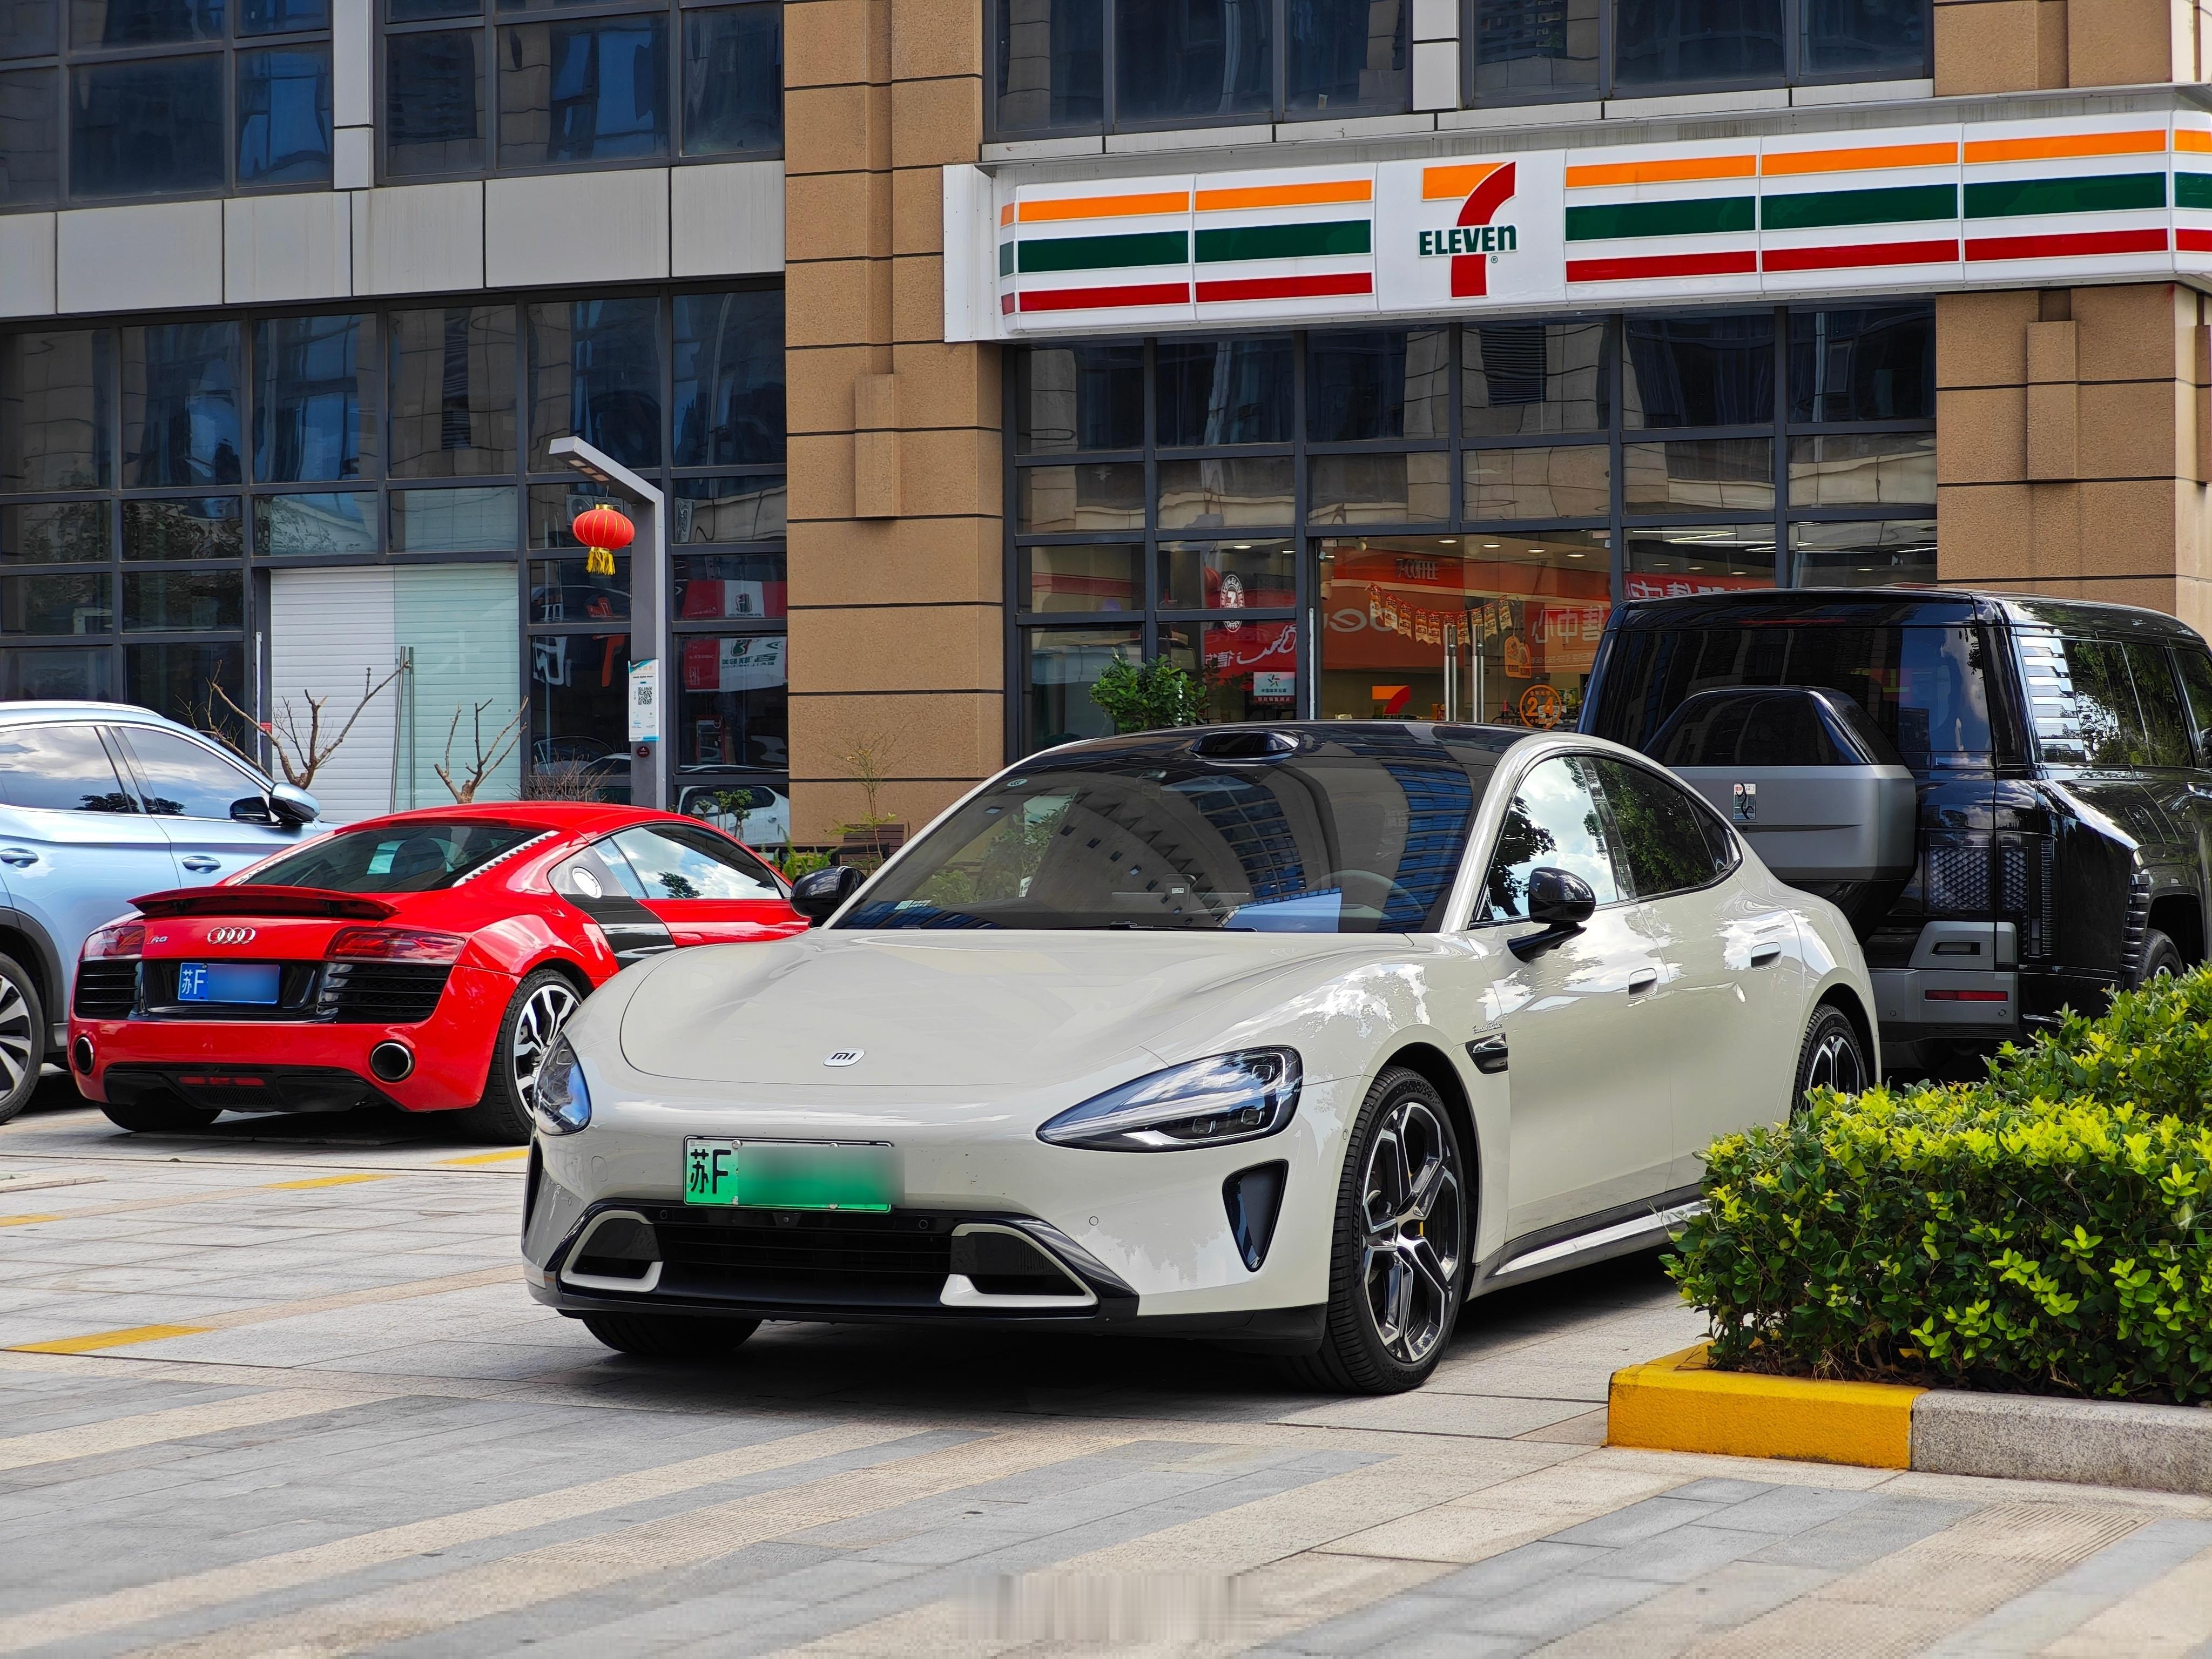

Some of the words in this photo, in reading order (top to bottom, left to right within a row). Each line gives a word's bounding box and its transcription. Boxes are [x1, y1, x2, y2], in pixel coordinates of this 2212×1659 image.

[181, 969, 206, 995] 苏F
[690, 1149, 732, 1195] 苏F
[1353, 1175, 1362, 1261] MICHELIN
